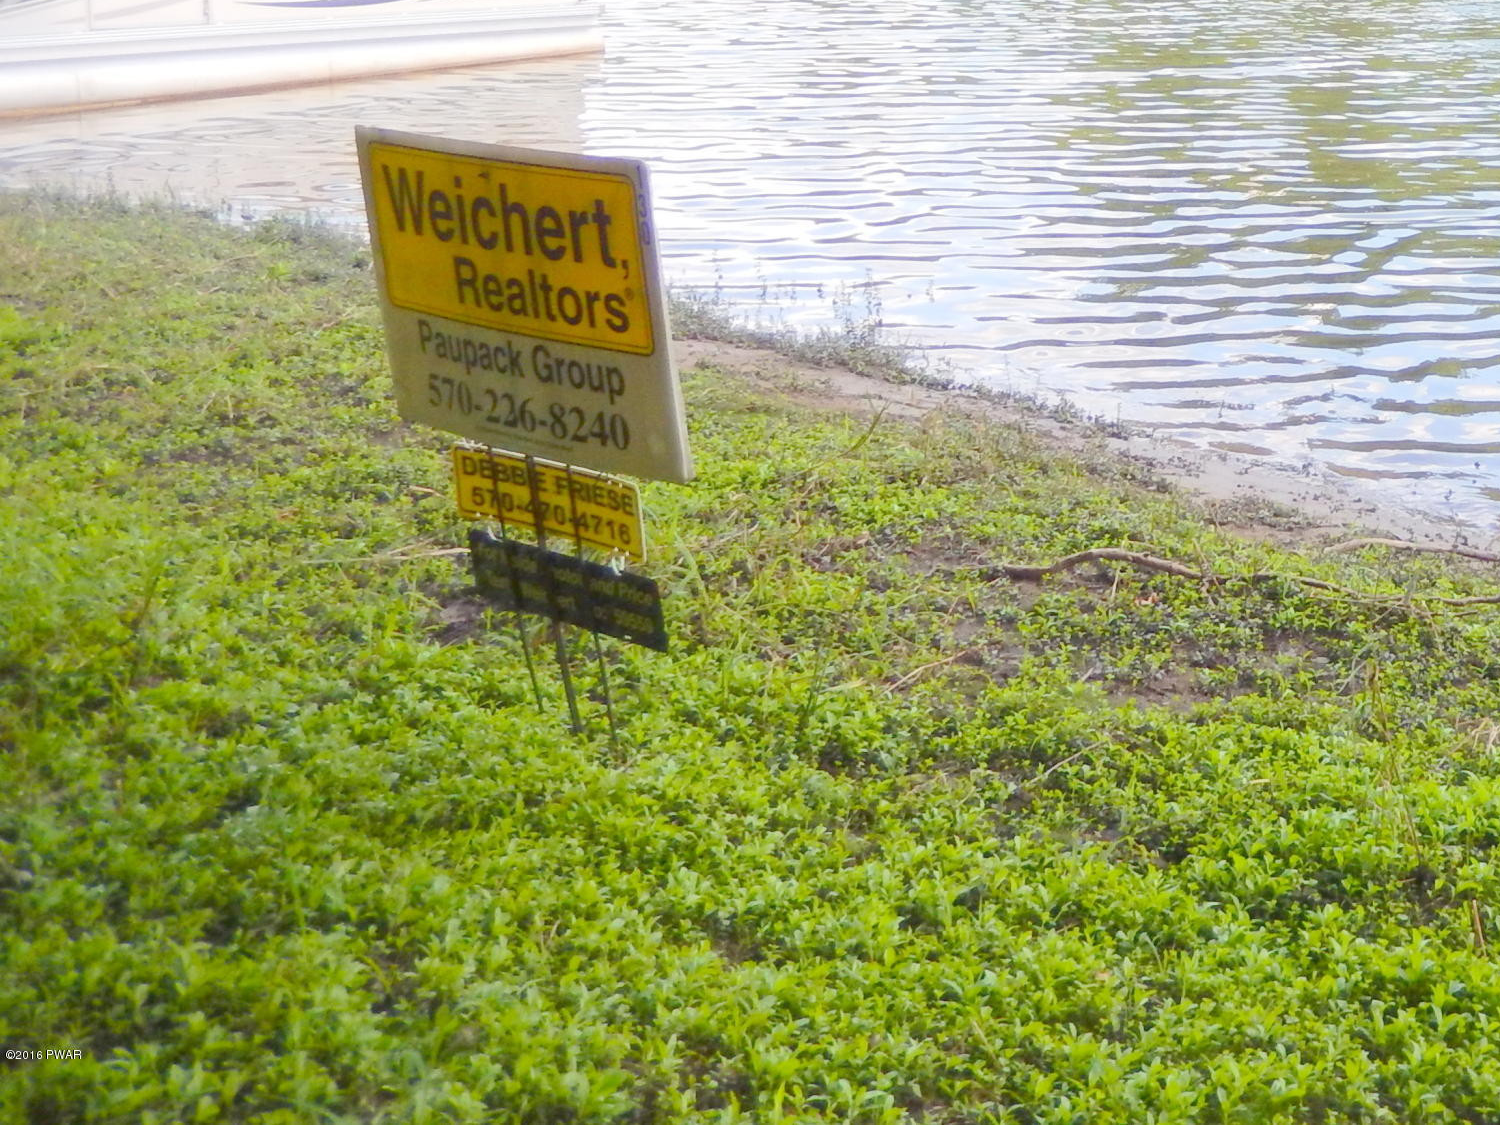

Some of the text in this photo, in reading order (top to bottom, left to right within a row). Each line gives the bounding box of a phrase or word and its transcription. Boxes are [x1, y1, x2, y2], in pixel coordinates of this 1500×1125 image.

[382, 164, 630, 279] Weichert,
[417, 320, 626, 404] Paupack Group
[429, 375, 631, 451] 570-226-8240
[461, 455, 547, 493] DEBBE
